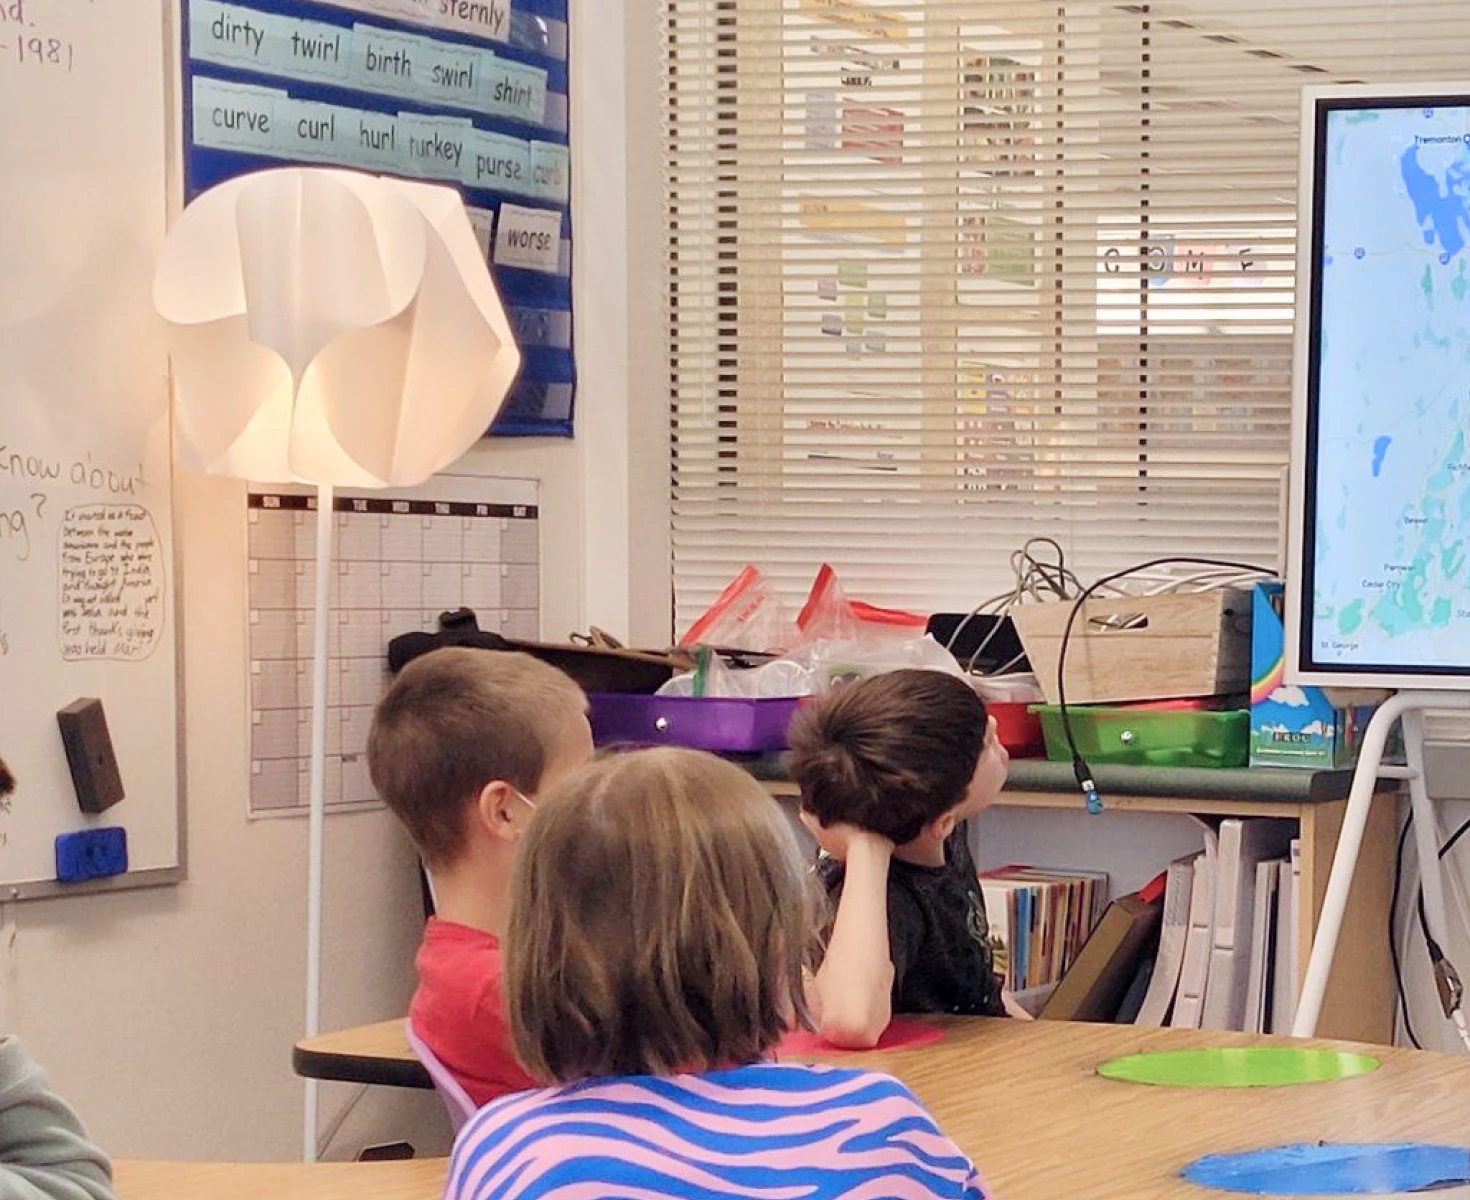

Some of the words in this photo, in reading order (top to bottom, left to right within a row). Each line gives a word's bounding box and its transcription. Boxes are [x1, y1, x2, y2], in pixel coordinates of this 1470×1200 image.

[211, 11, 265, 56] dirty
[290, 31, 341, 62] twirl
[366, 43, 411, 78] birth
[431, 61, 473, 89] swirl
[493, 75, 532, 105] shirt
[212, 107, 271, 134] curve
[297, 112, 336, 141] curl
[359, 118, 396, 151] hurl
[409, 131, 463, 167] turkey
[476, 152, 522, 180] purse
[1413, 133, 1462, 144] Tremonton
[507, 228, 551, 252] worse
[70, 451, 155, 496] about
[1361, 579, 1385, 588] Cedar
